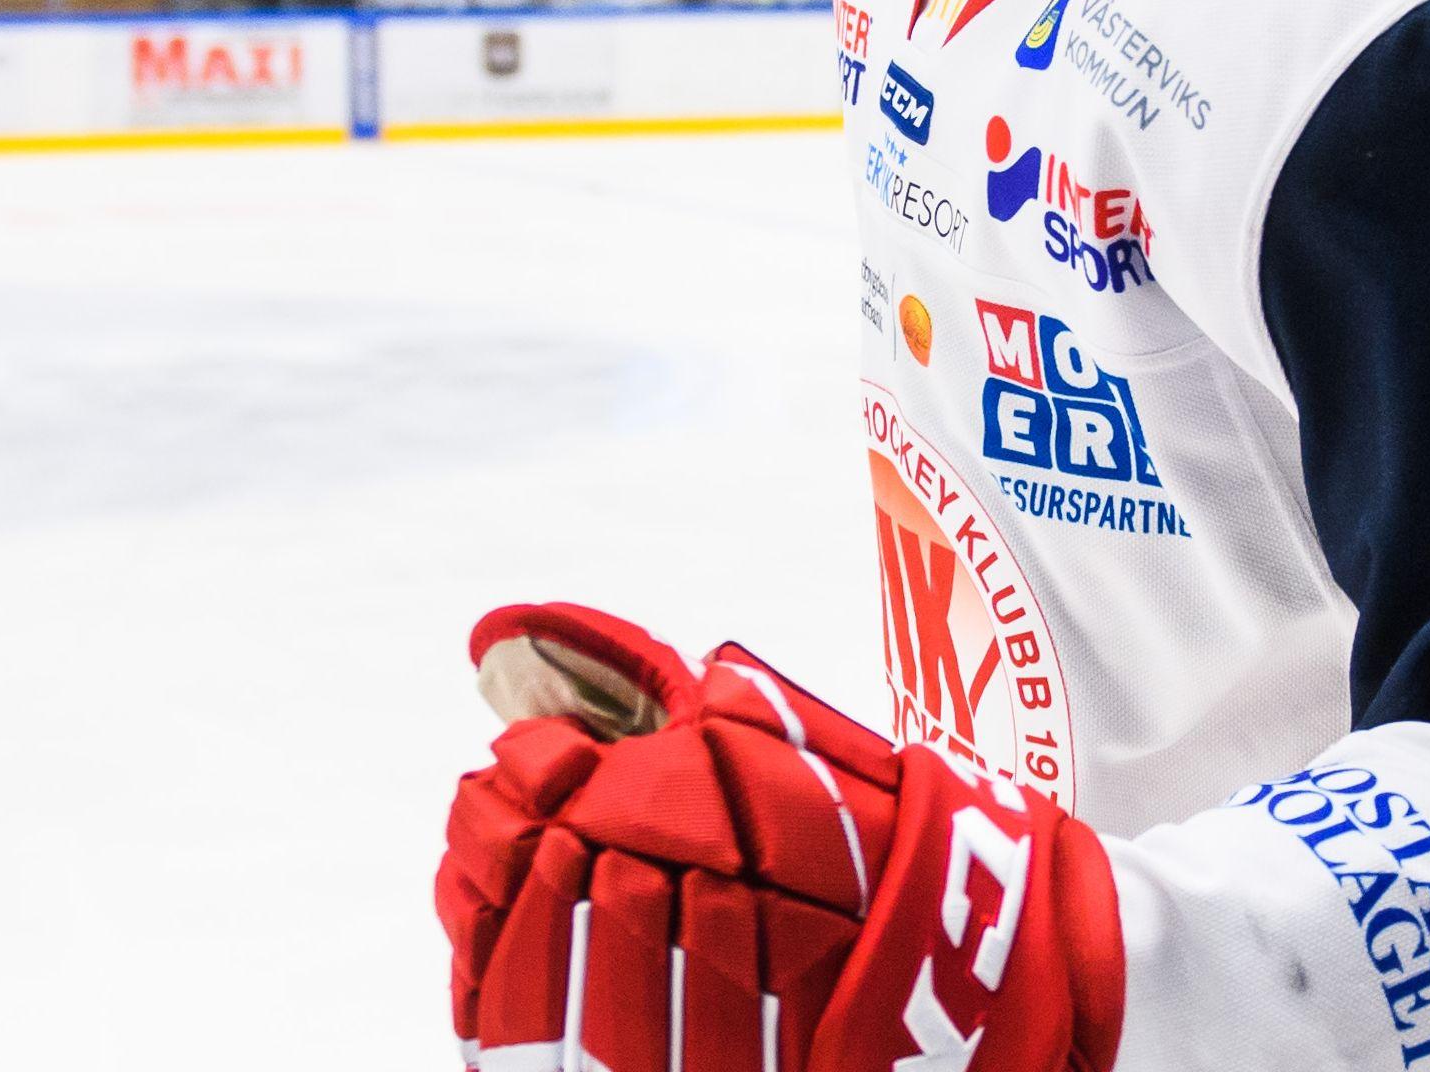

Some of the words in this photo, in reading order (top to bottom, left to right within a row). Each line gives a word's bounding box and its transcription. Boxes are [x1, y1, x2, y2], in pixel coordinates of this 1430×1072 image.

[880, 80, 930, 129] CCM
[1065, 29, 1161, 131] KOMMUN
[865, 142, 969, 255] ERIKRESORT
[955, 513, 1053, 710] KLUBB
